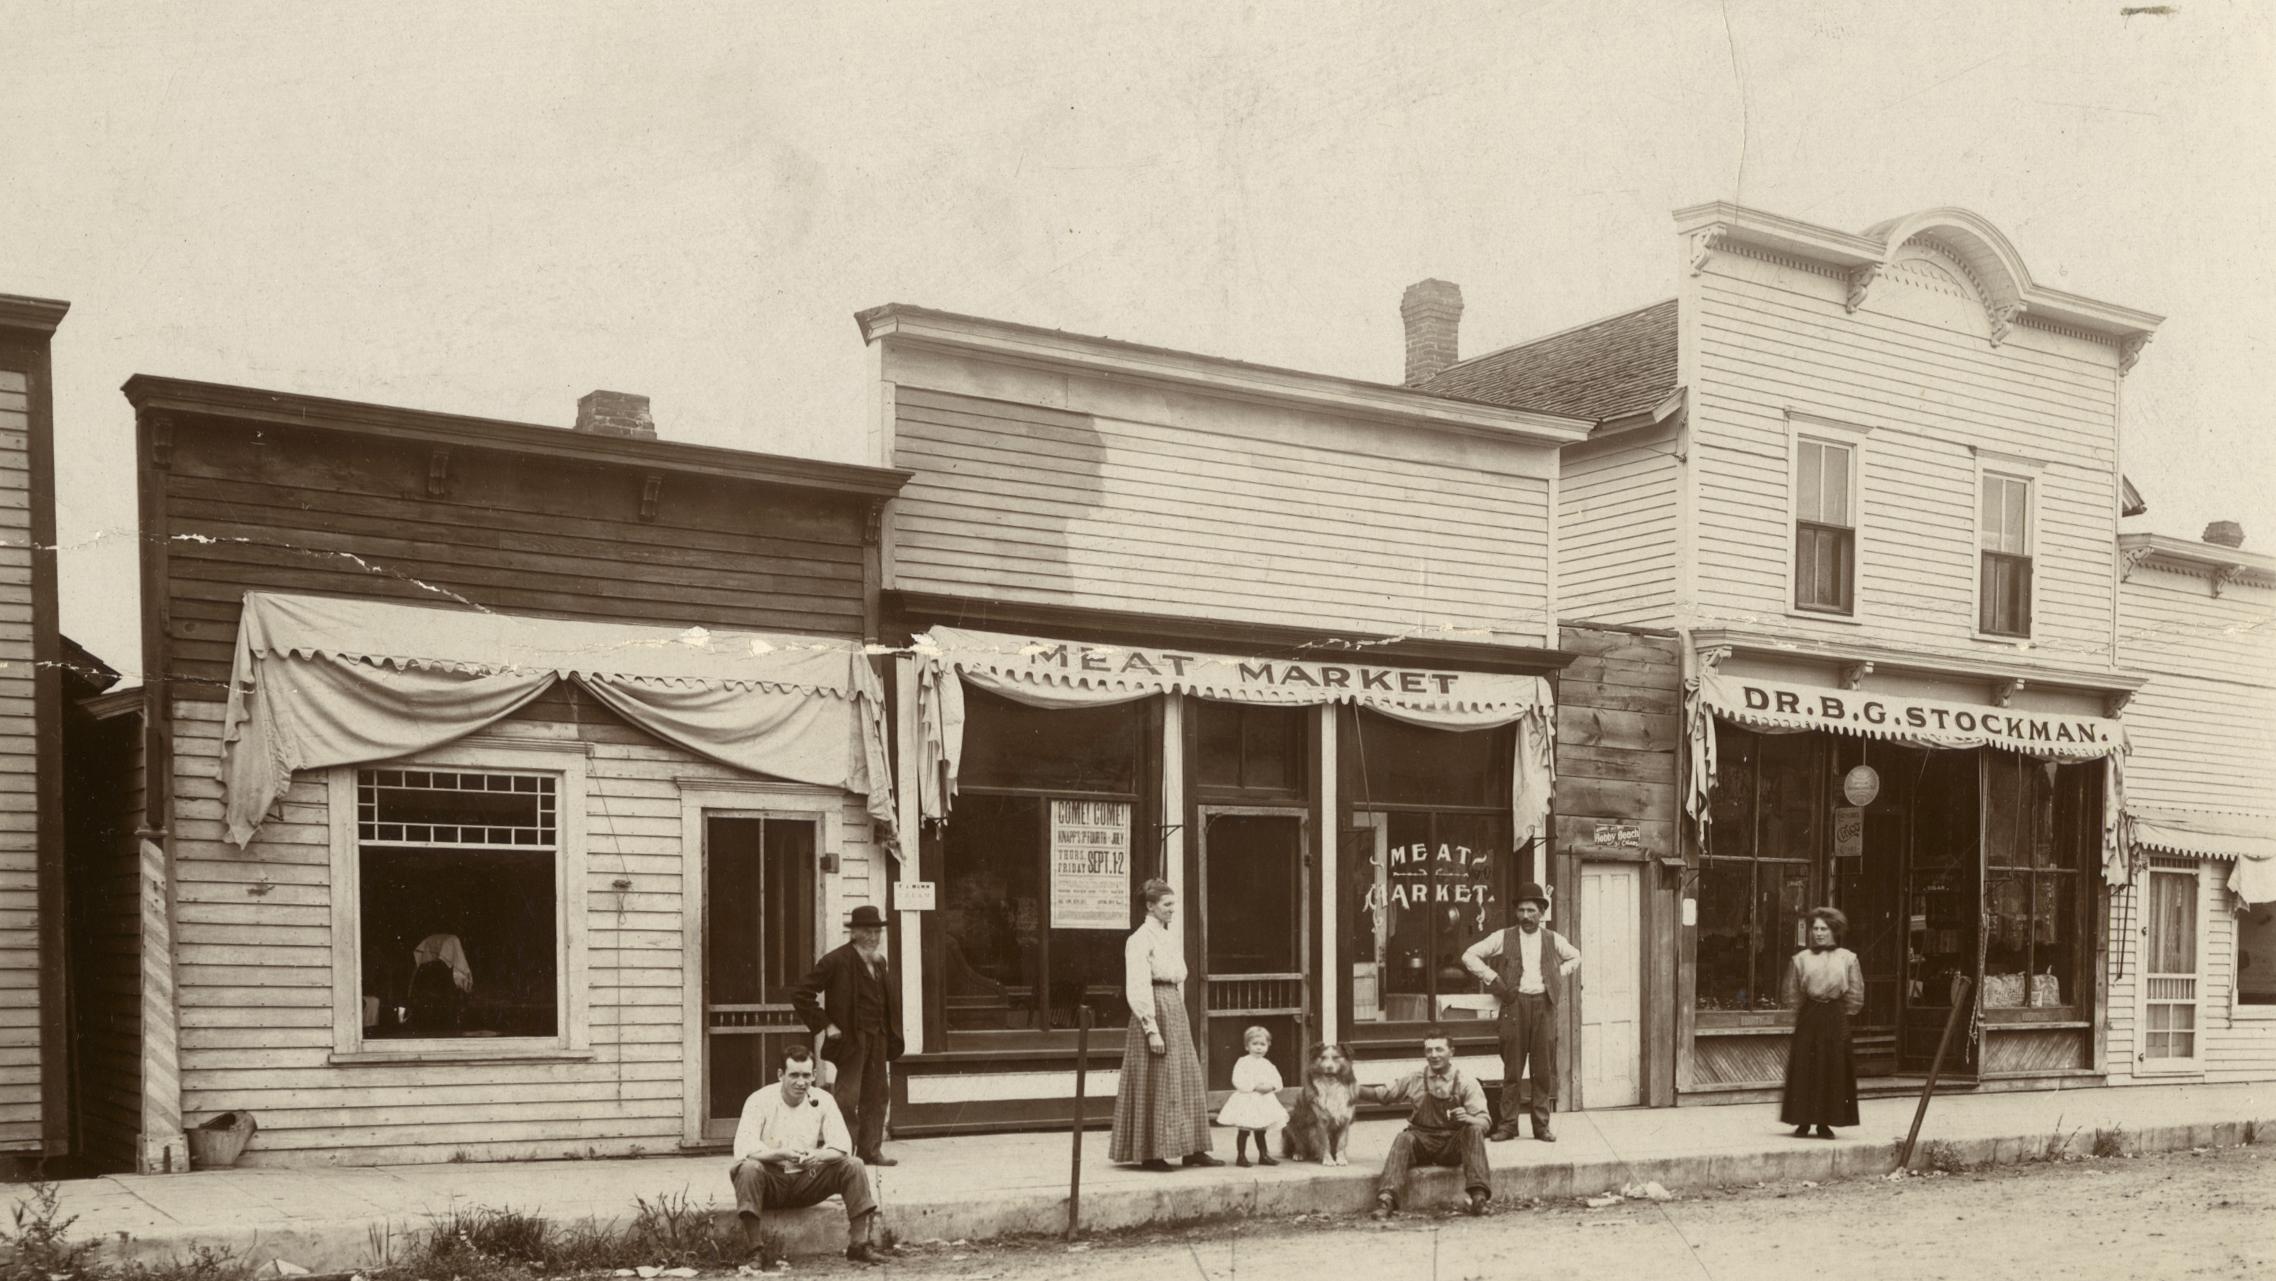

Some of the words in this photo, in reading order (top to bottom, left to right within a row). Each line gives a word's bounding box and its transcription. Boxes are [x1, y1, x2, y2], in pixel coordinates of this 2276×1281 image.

[1029, 640, 1195, 677] MEAT
[1236, 660, 1460, 695] MARKET
[1058, 800, 1091, 825] COME!
[1093, 802, 1125, 827] COME!
[1390, 843, 1472, 867] MEAT
[1057, 862, 1087, 874] FRIDAY
